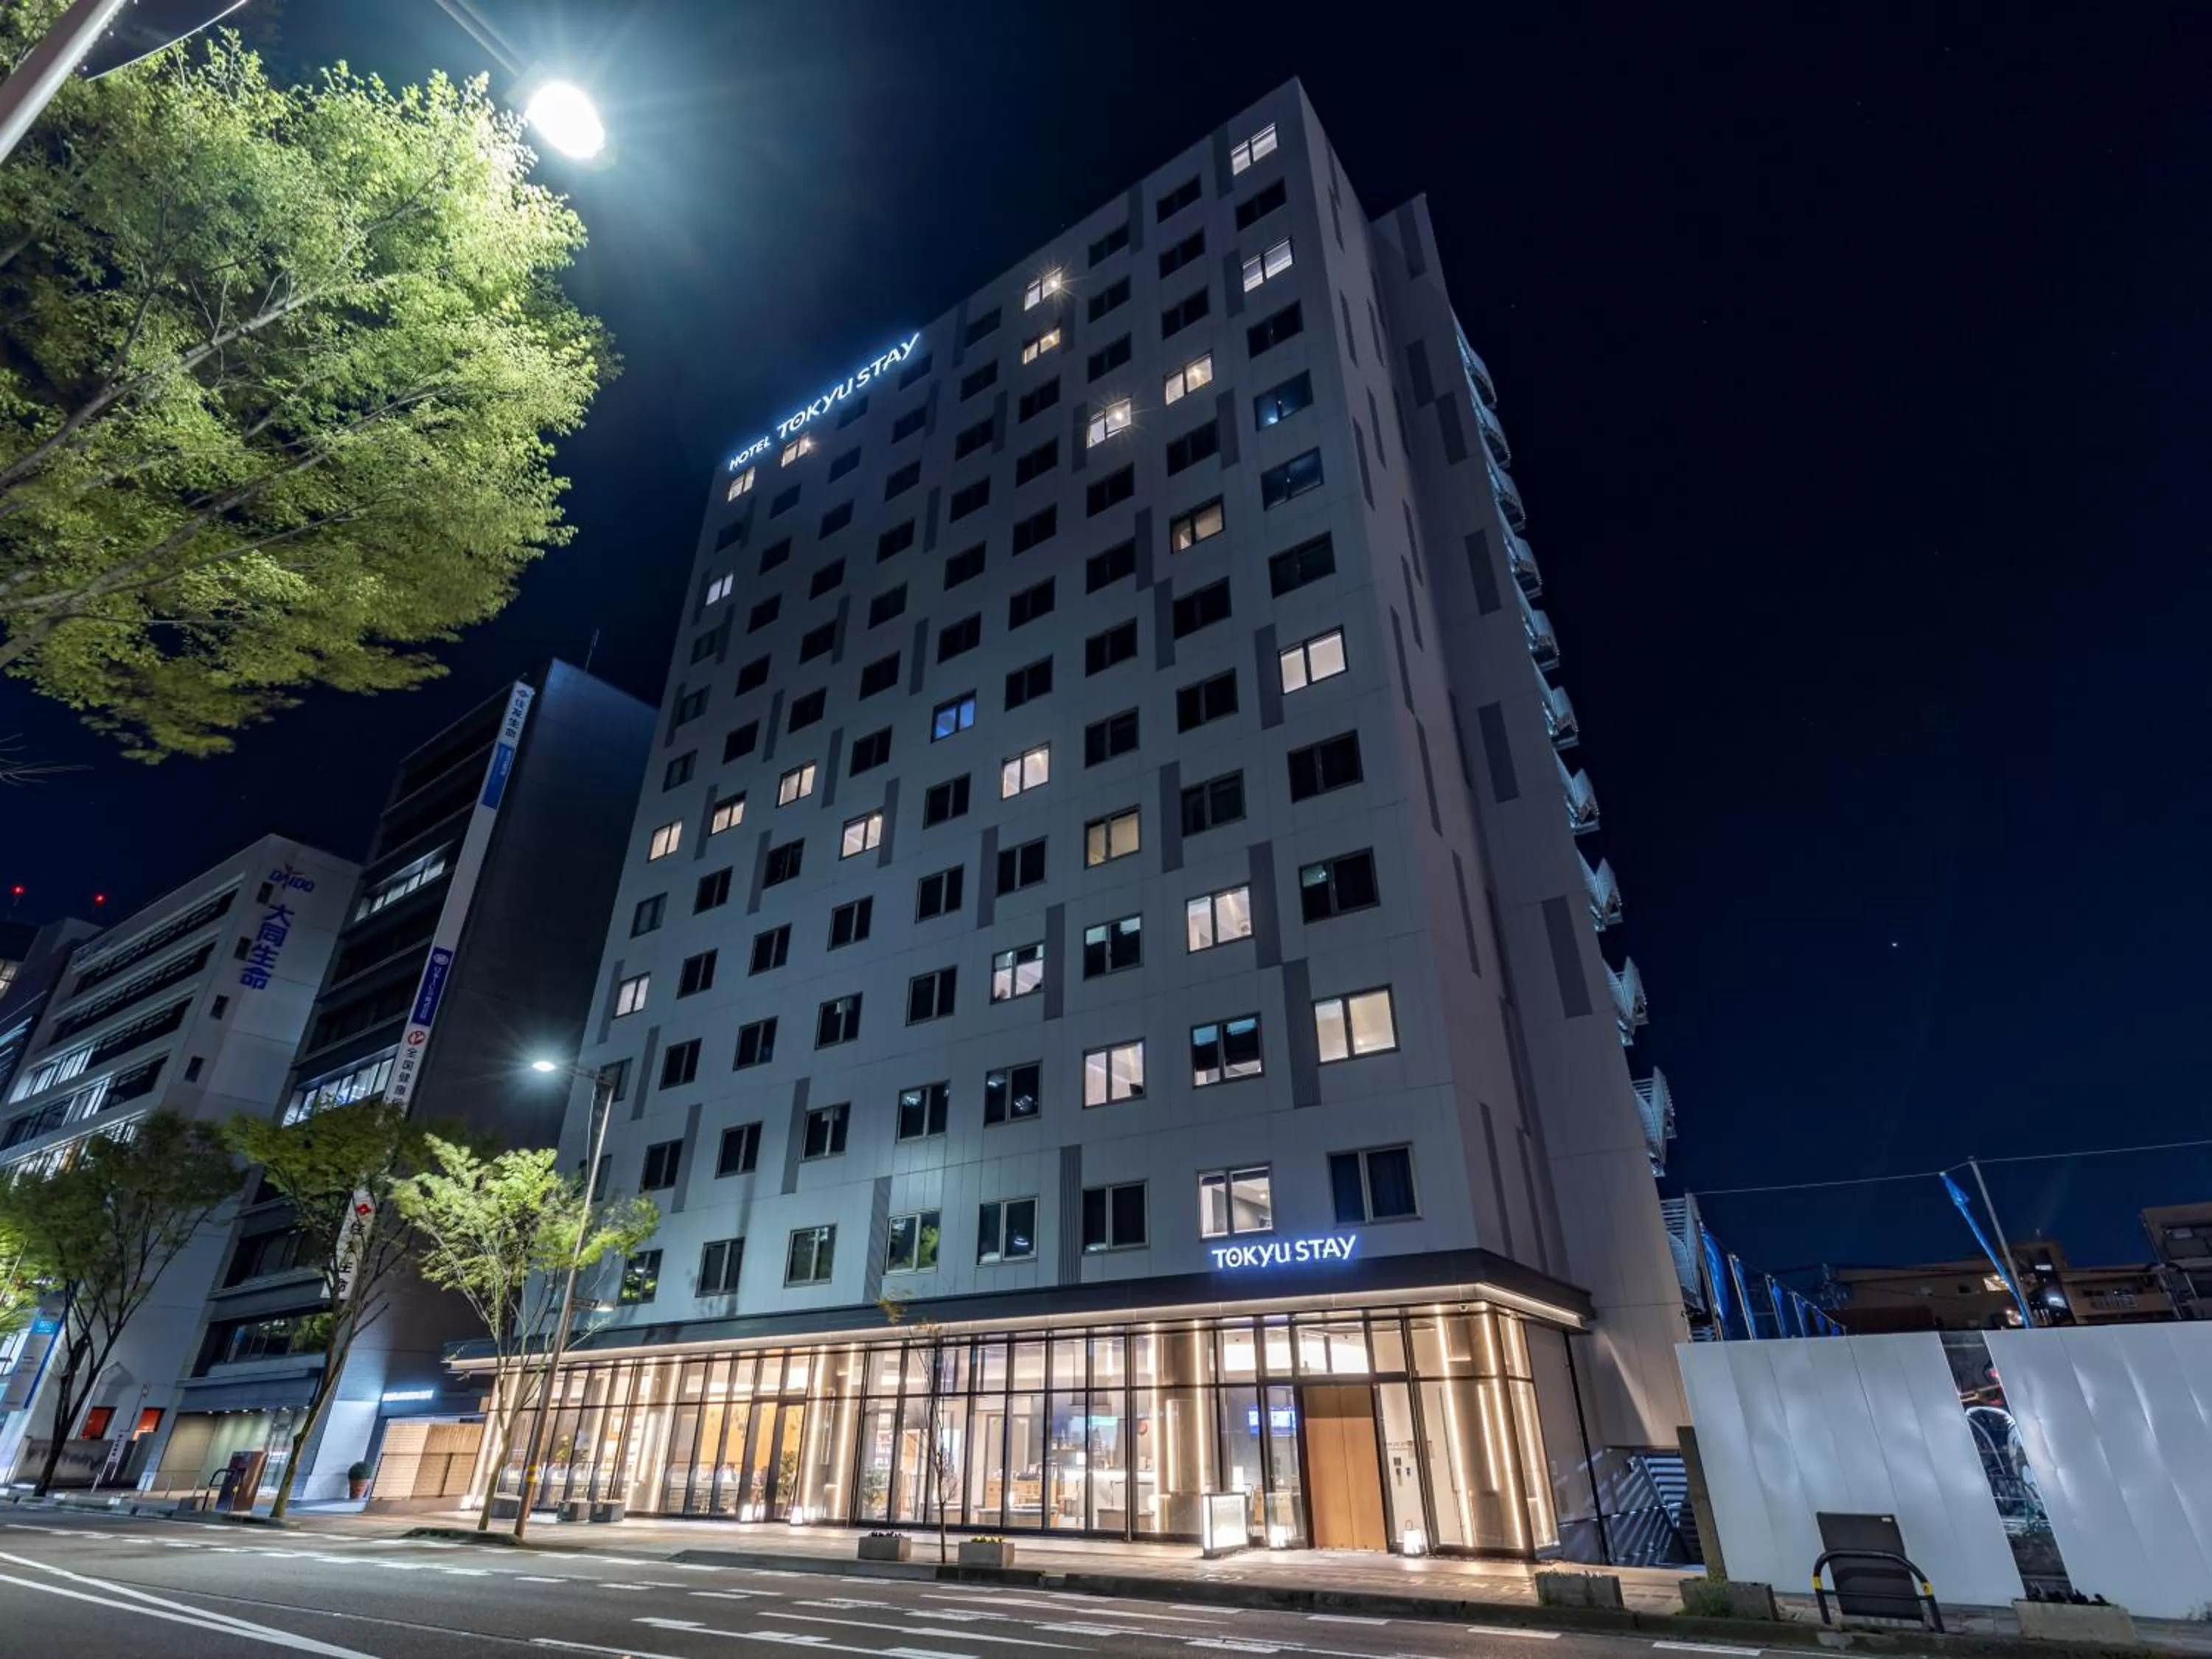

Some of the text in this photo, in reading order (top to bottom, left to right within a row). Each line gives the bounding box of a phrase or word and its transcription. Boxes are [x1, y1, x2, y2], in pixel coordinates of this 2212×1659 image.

[728, 332, 920, 470] HOTEL TOKYU STAY
[240, 904, 295, 990] 大同生命
[1211, 1234, 1356, 1268] TOKYU STAY
